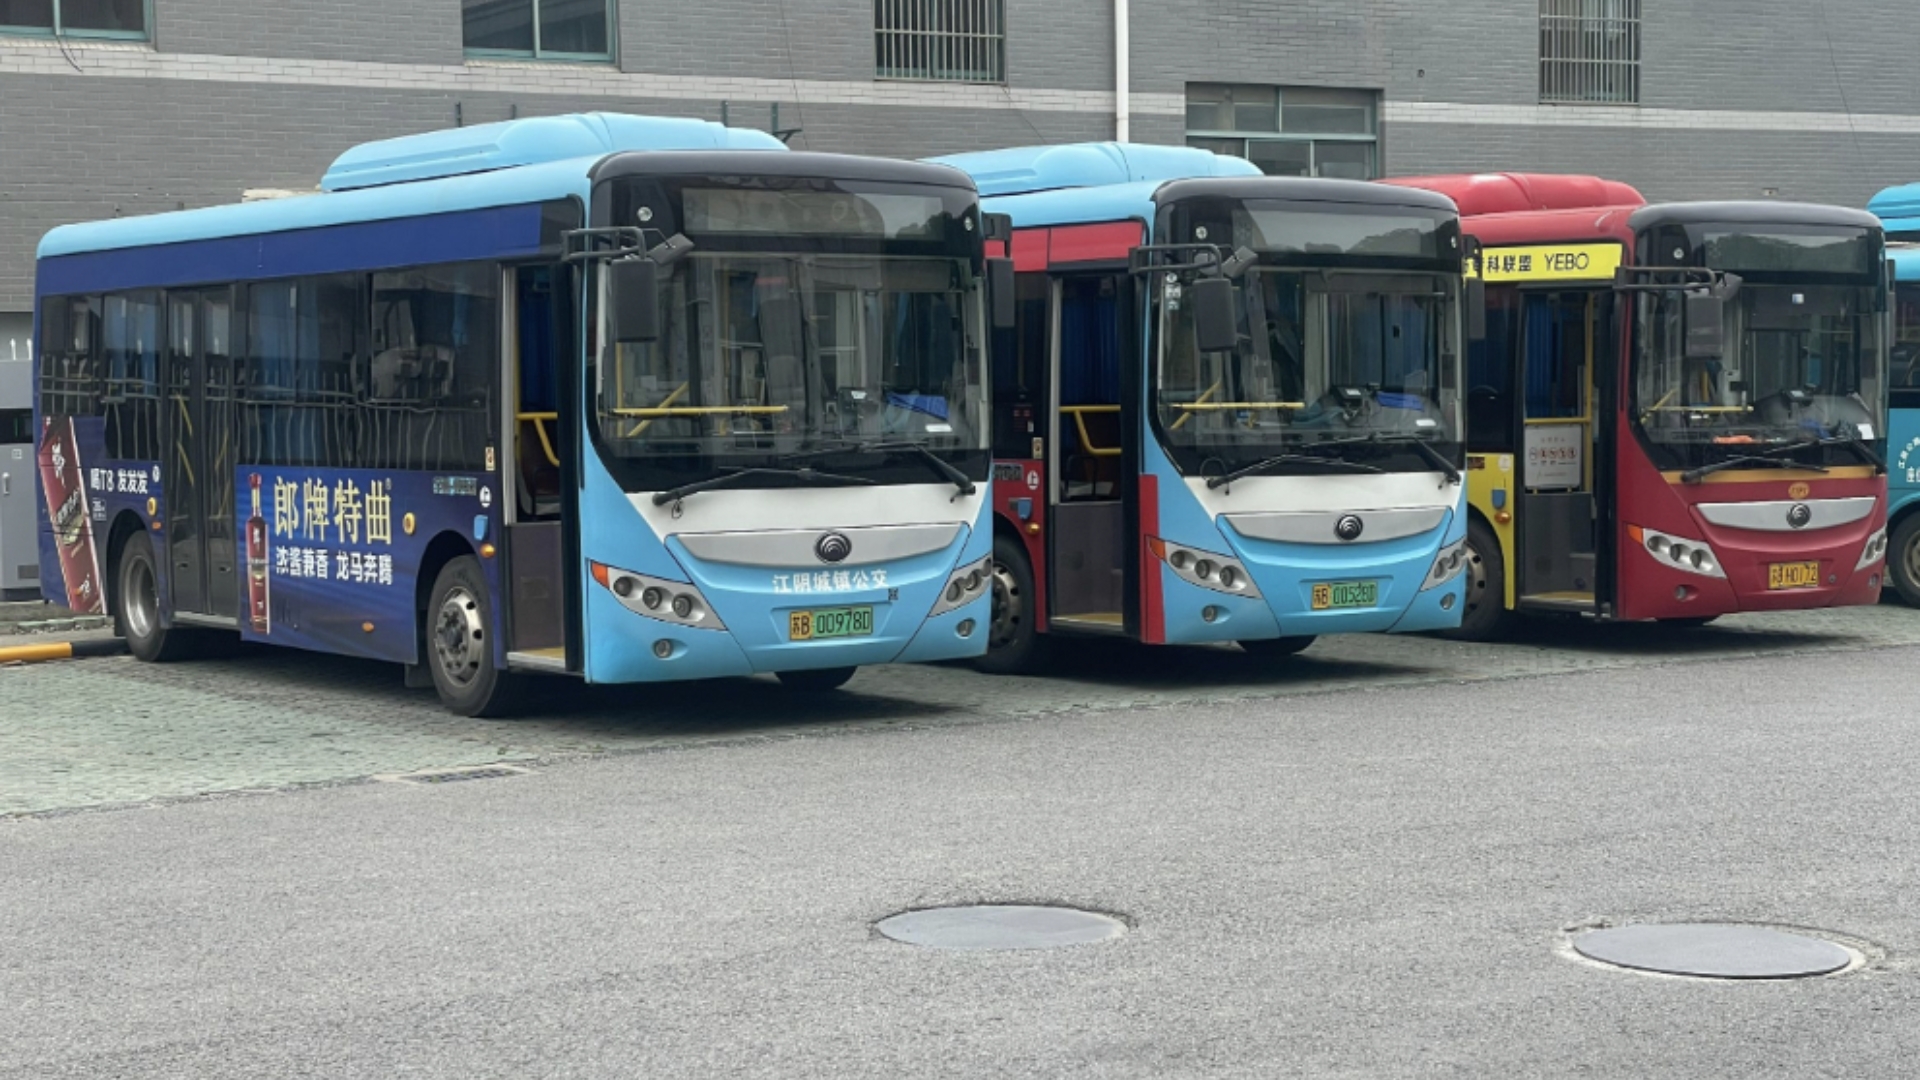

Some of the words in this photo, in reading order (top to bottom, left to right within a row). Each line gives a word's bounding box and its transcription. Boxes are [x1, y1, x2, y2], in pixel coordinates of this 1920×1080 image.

[1545, 253, 1589, 271] YEBO
[274, 476, 391, 545] 郎牌特曲
[276, 546, 328, 579] 浓酱兼香
[336, 551, 392, 585] 龙马奔腾
[772, 569, 888, 594] 江阴城镇公交
